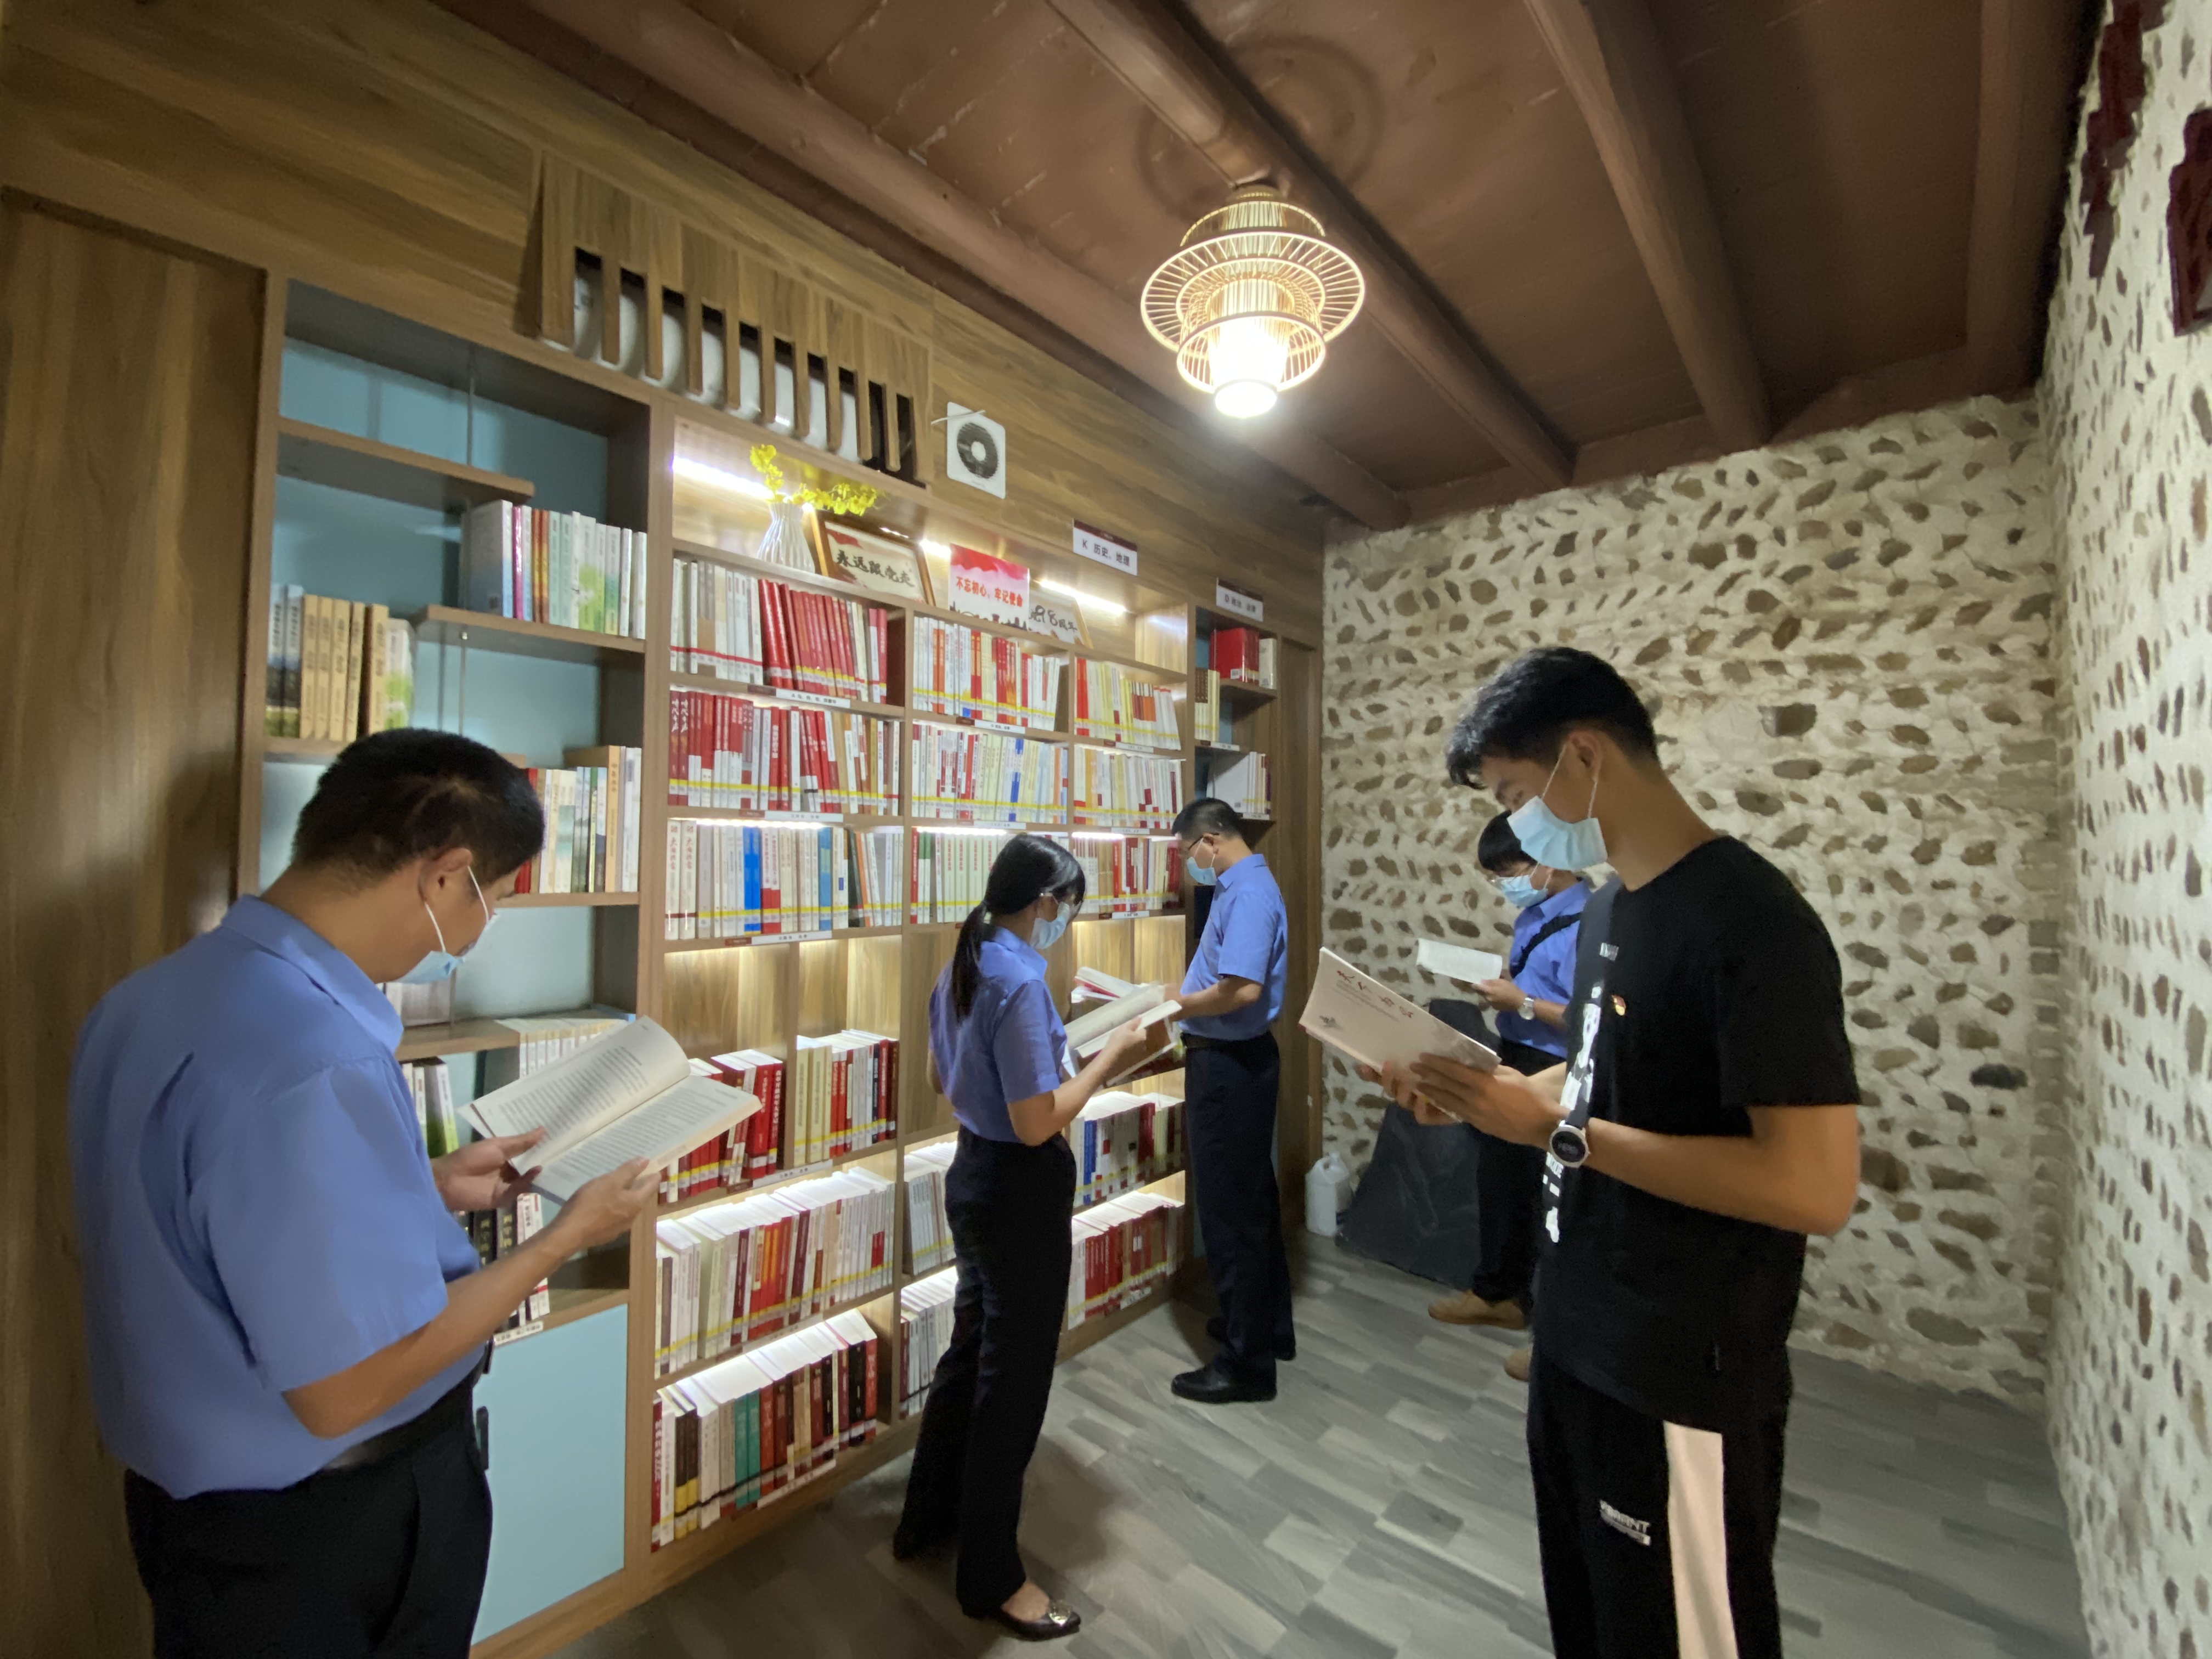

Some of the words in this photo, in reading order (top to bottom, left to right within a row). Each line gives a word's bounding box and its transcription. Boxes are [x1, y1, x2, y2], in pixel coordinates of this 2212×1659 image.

[836, 549, 915, 588] 永远跟党走
[1082, 539, 1087, 549] K
[1094, 543, 1130, 567] 历史、地理
